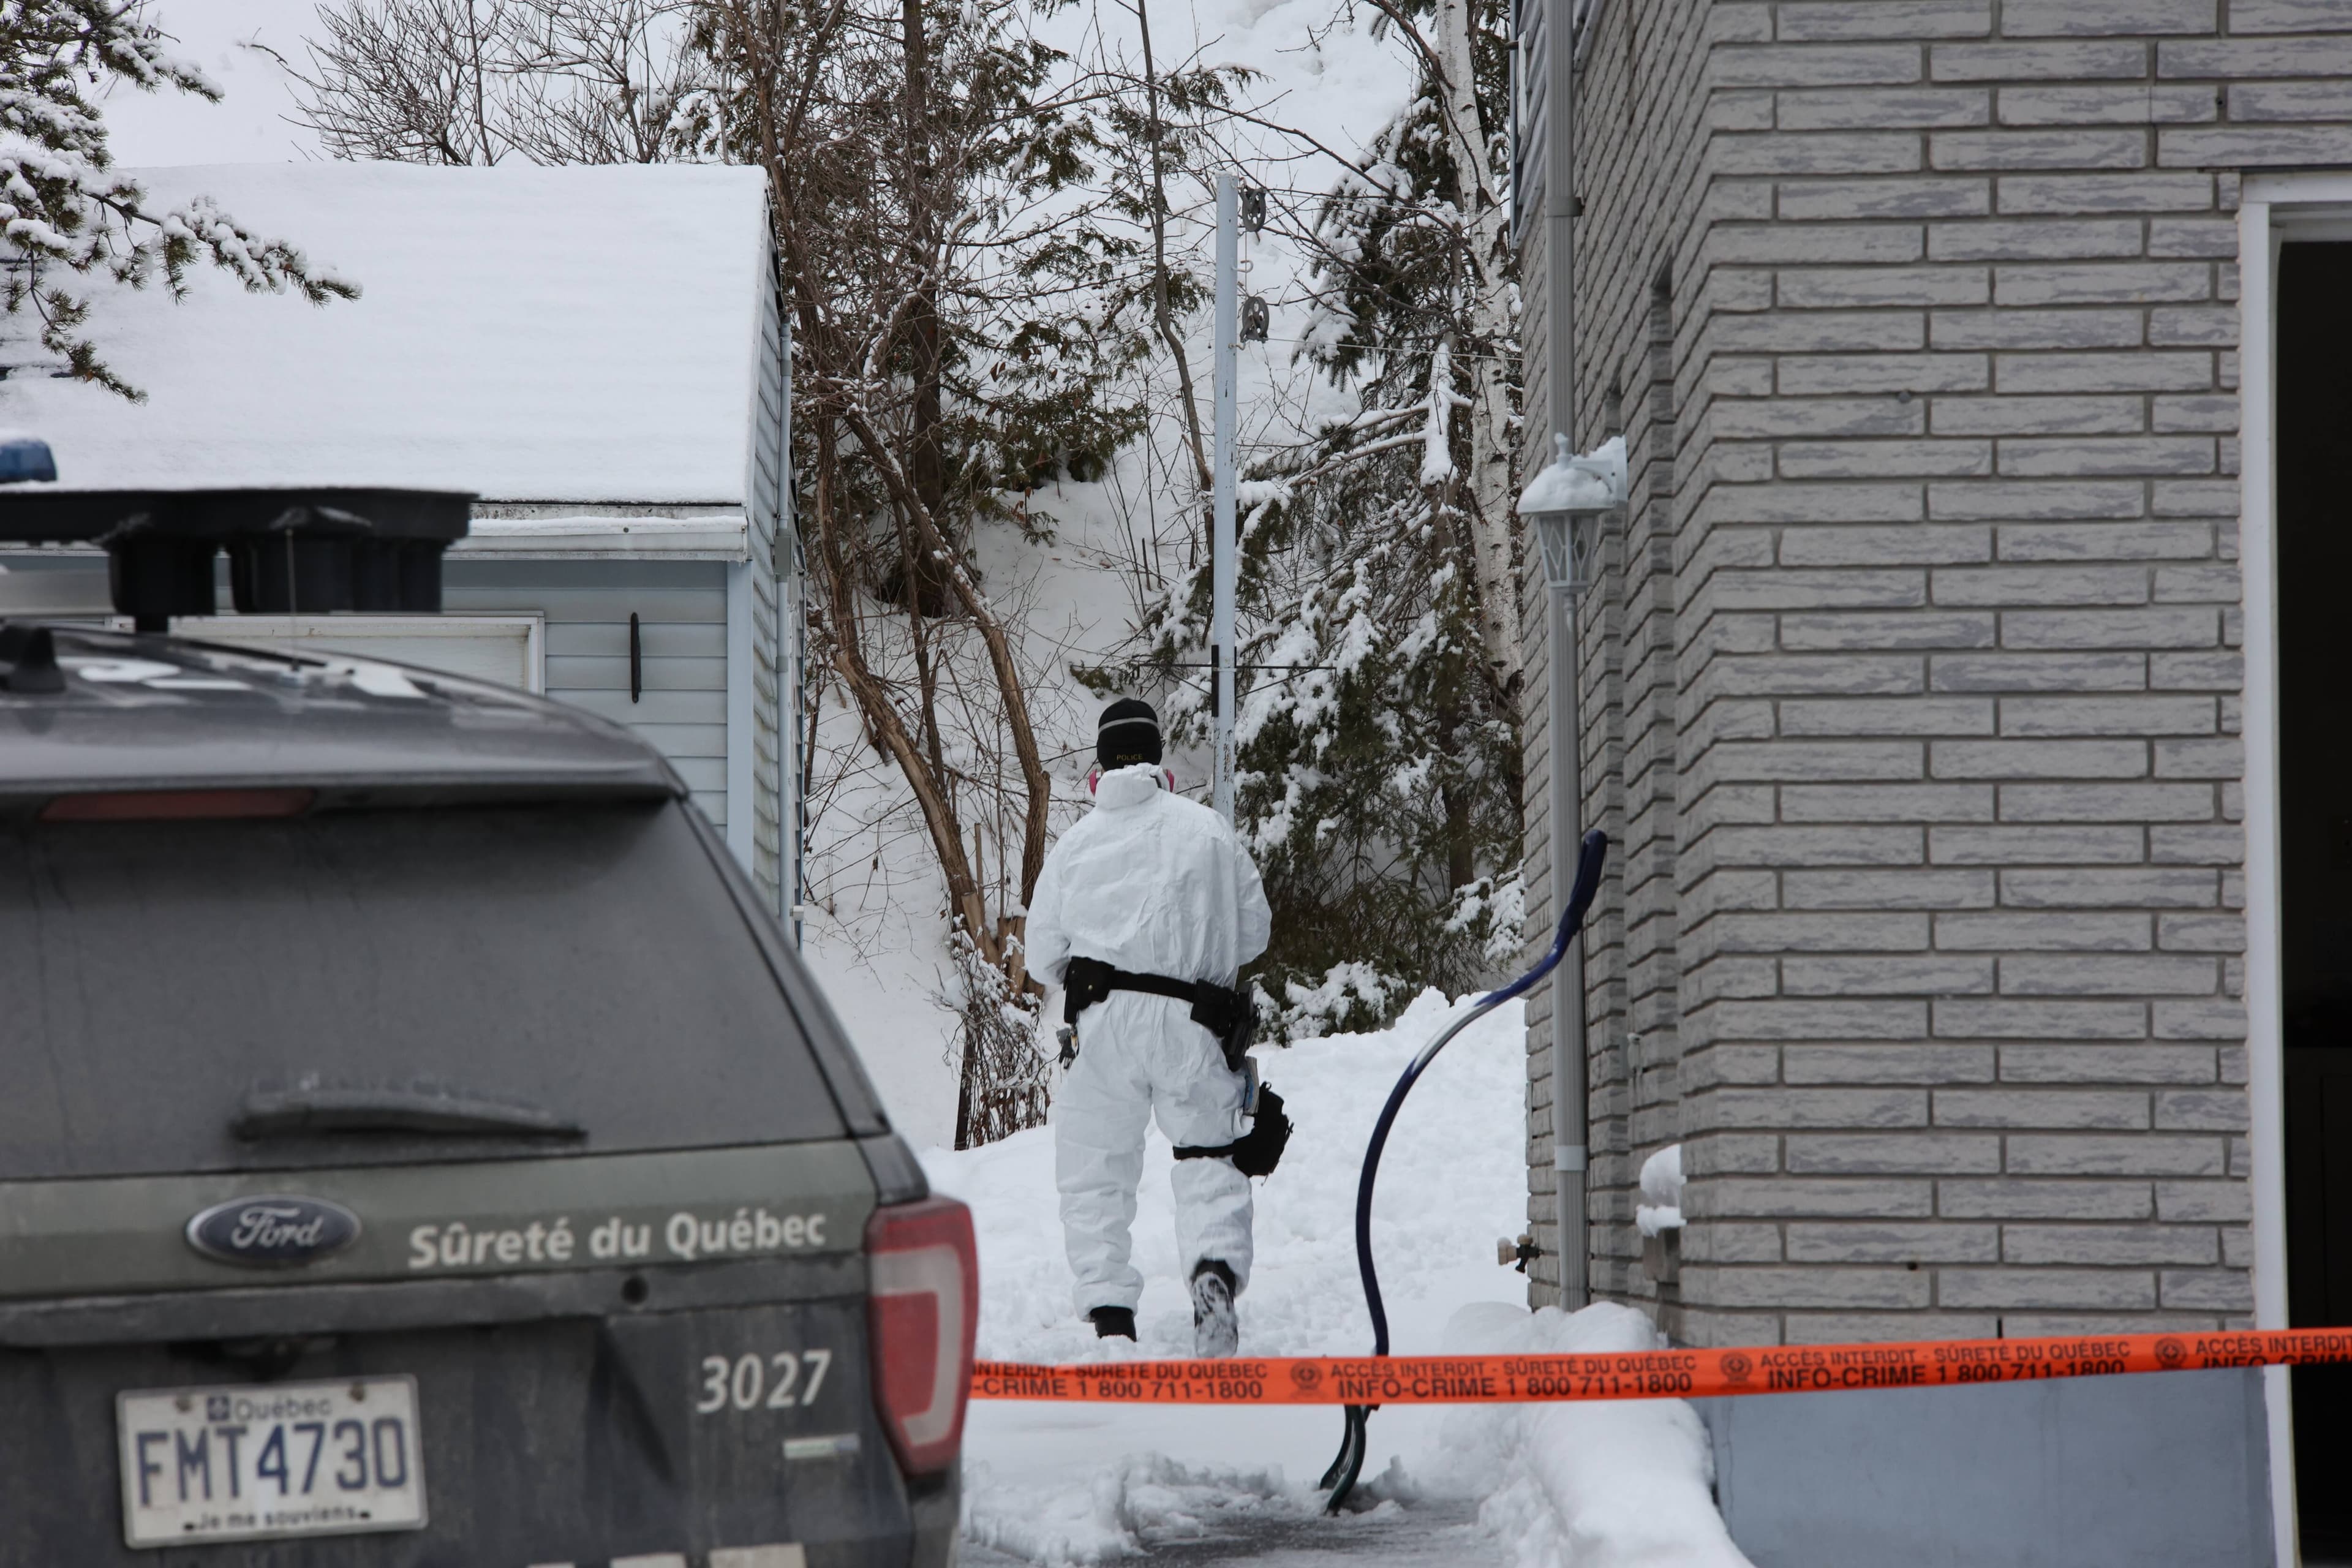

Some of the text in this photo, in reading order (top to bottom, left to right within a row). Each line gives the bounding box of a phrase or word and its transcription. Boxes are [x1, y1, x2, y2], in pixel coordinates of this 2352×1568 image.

[231, 1206, 324, 1248] Ford
[409, 1208, 826, 1268] Sûreté du Québec
[1761, 1349, 1825, 1368] ACCÈS
[1831, 1349, 1917, 1366] INTERDIT
[2016, 1345, 2043, 1360] DU
[2049, 1340, 2132, 1360] QUÉBEC
[2195, 1335, 2263, 1355] ACCÈS
[1156, 1363, 1182, 1379] DU
[1331, 1360, 1395, 1378] ACCÈS
[1401, 1362, 1484, 1378] INTERDIT
[1585, 1359, 1611, 1374] DU
[1617, 1355, 1697, 1374] QUÉBEC
[1768, 1359, 2125, 1389] INFO-CRIME 1 800 711-1800
[696, 1349, 832, 1414] 3027
[1077, 1381, 1087, 1396] 1
[1099, 1381, 1142, 1399] 800
[1150, 1381, 1263, 1399] 711-1800
[1338, 1373, 1692, 1399] INFO-CRIME 1 800 711-1800
[135, 1415, 408, 1507] FMT4730
